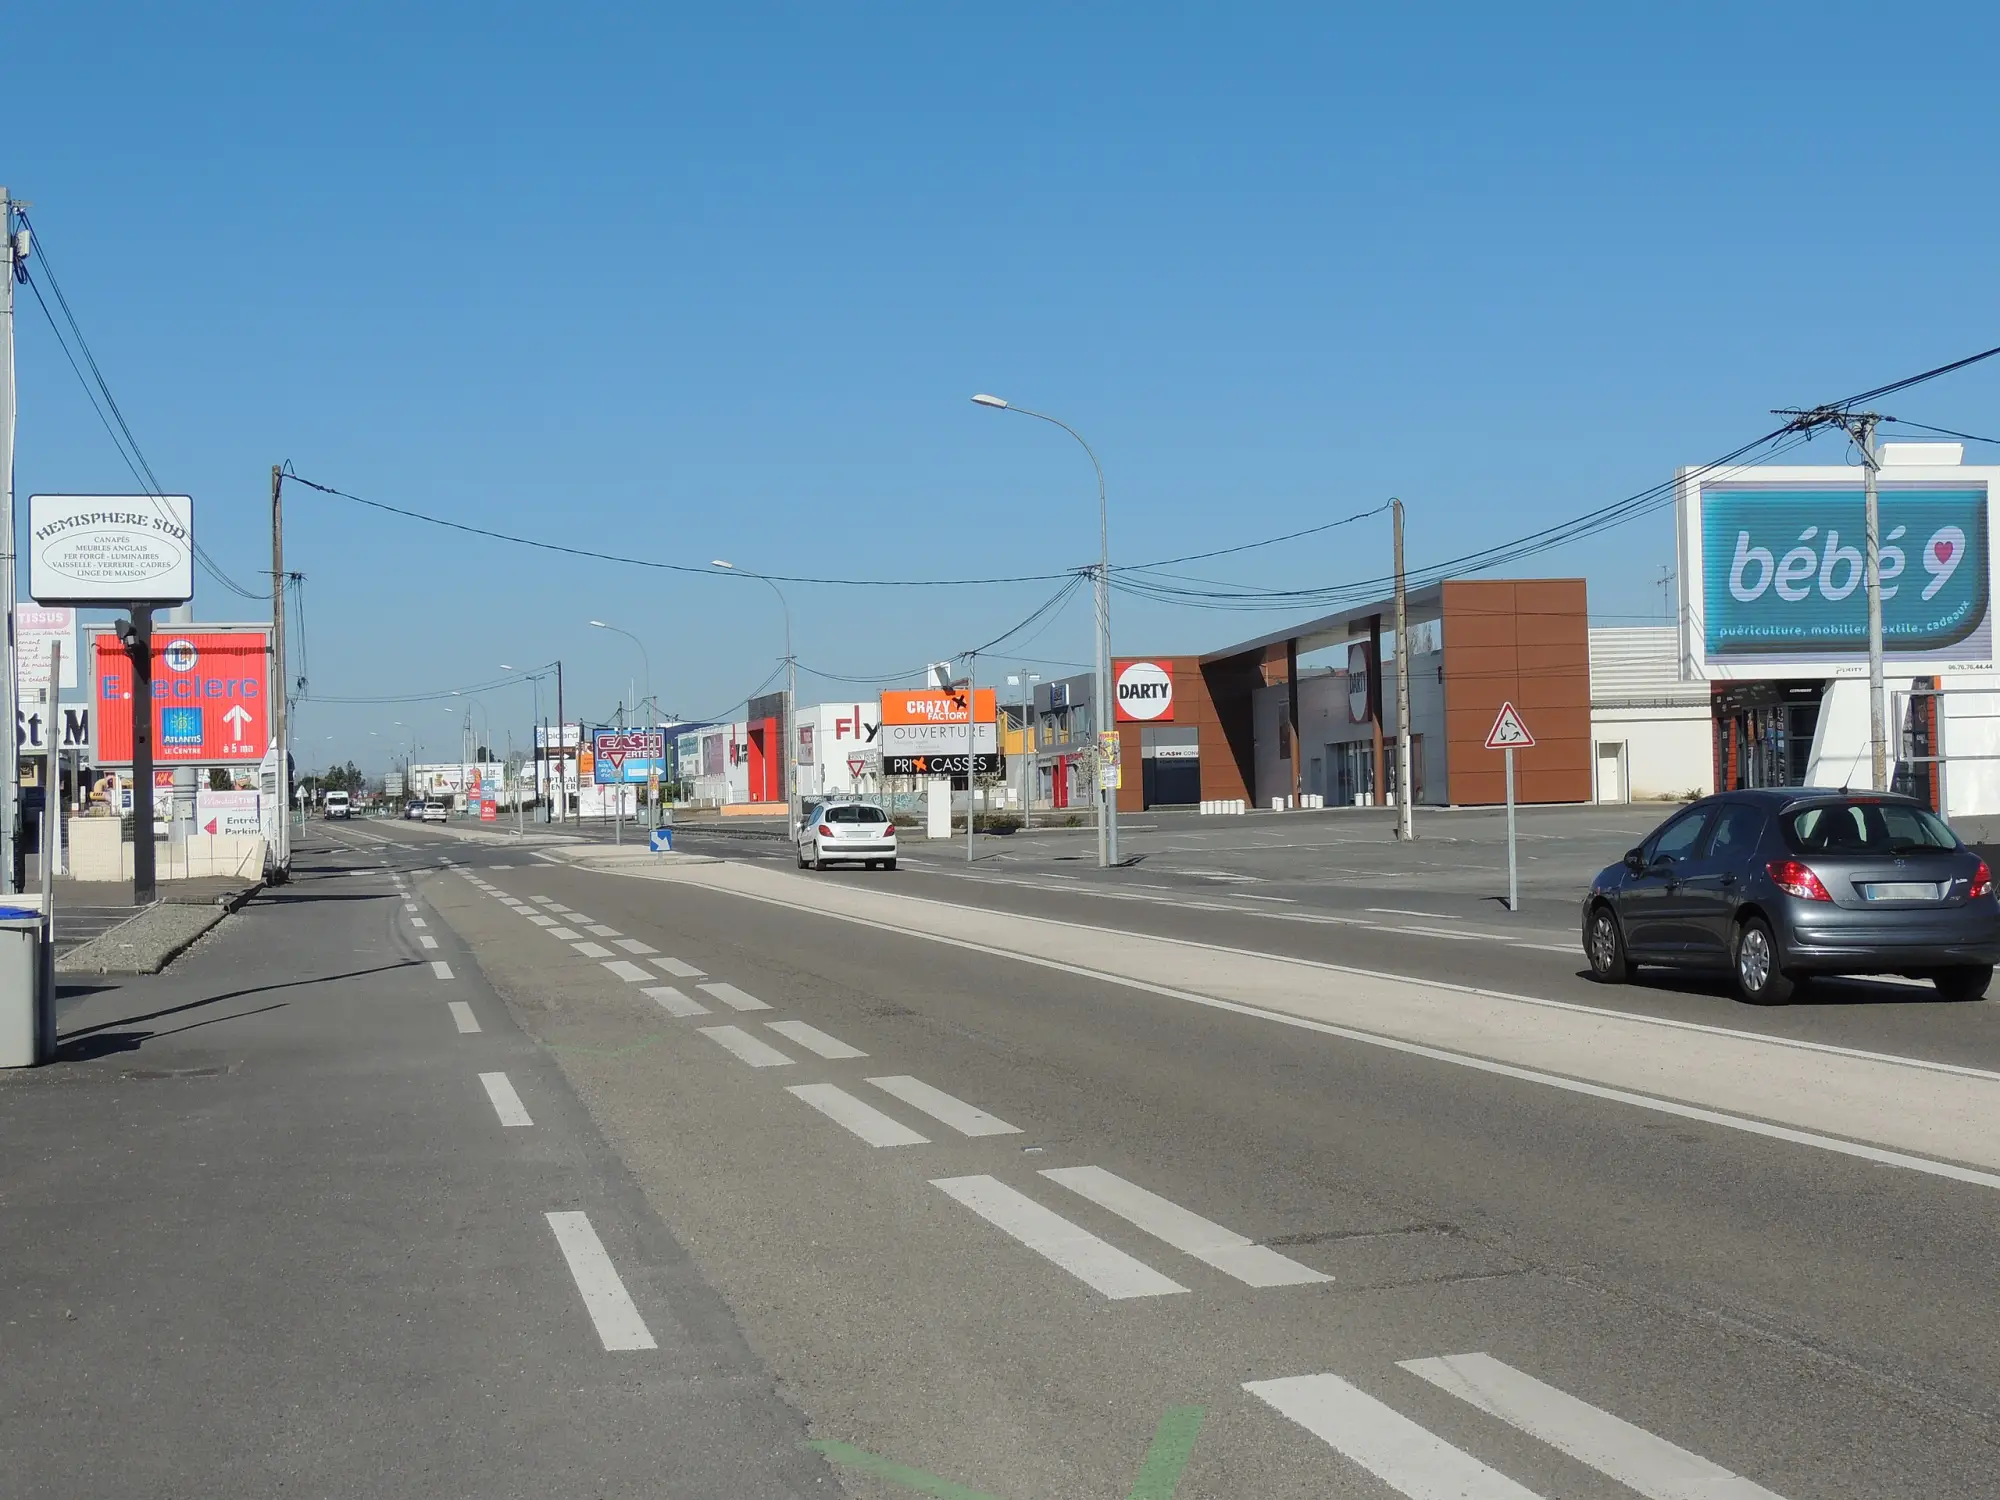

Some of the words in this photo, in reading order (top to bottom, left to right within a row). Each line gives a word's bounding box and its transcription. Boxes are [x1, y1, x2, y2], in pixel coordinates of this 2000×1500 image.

[36, 512, 148, 541] HEMISPHERE
[152, 517, 186, 540] SUD
[94, 535, 130, 543] CANAPÉS
[79, 552, 105, 560] FORGÉ
[1729, 525, 1906, 602] bébé
[1921, 525, 1966, 601] 9
[18, 611, 64, 624] TISSUS
[1720, 623, 1806, 638] puériculture,
[1881, 623, 1923, 635] extile,
[1926, 600, 1970, 632] cadeaux
[1119, 683, 1170, 699] DARTY
[906, 700, 951, 714] CRAZY
[928, 711, 968, 721] FACTORY
[63, 709, 89, 746] M
[836, 705, 880, 743] Fly
[164, 734, 202, 743] ATLANTIS
[894, 725, 985, 740] OUVERTURE
[173, 746, 201, 755] CENTRE
[223, 743, 229, 753] à
[231, 743, 237, 753] 5
[225, 827, 260, 835] Parkin
